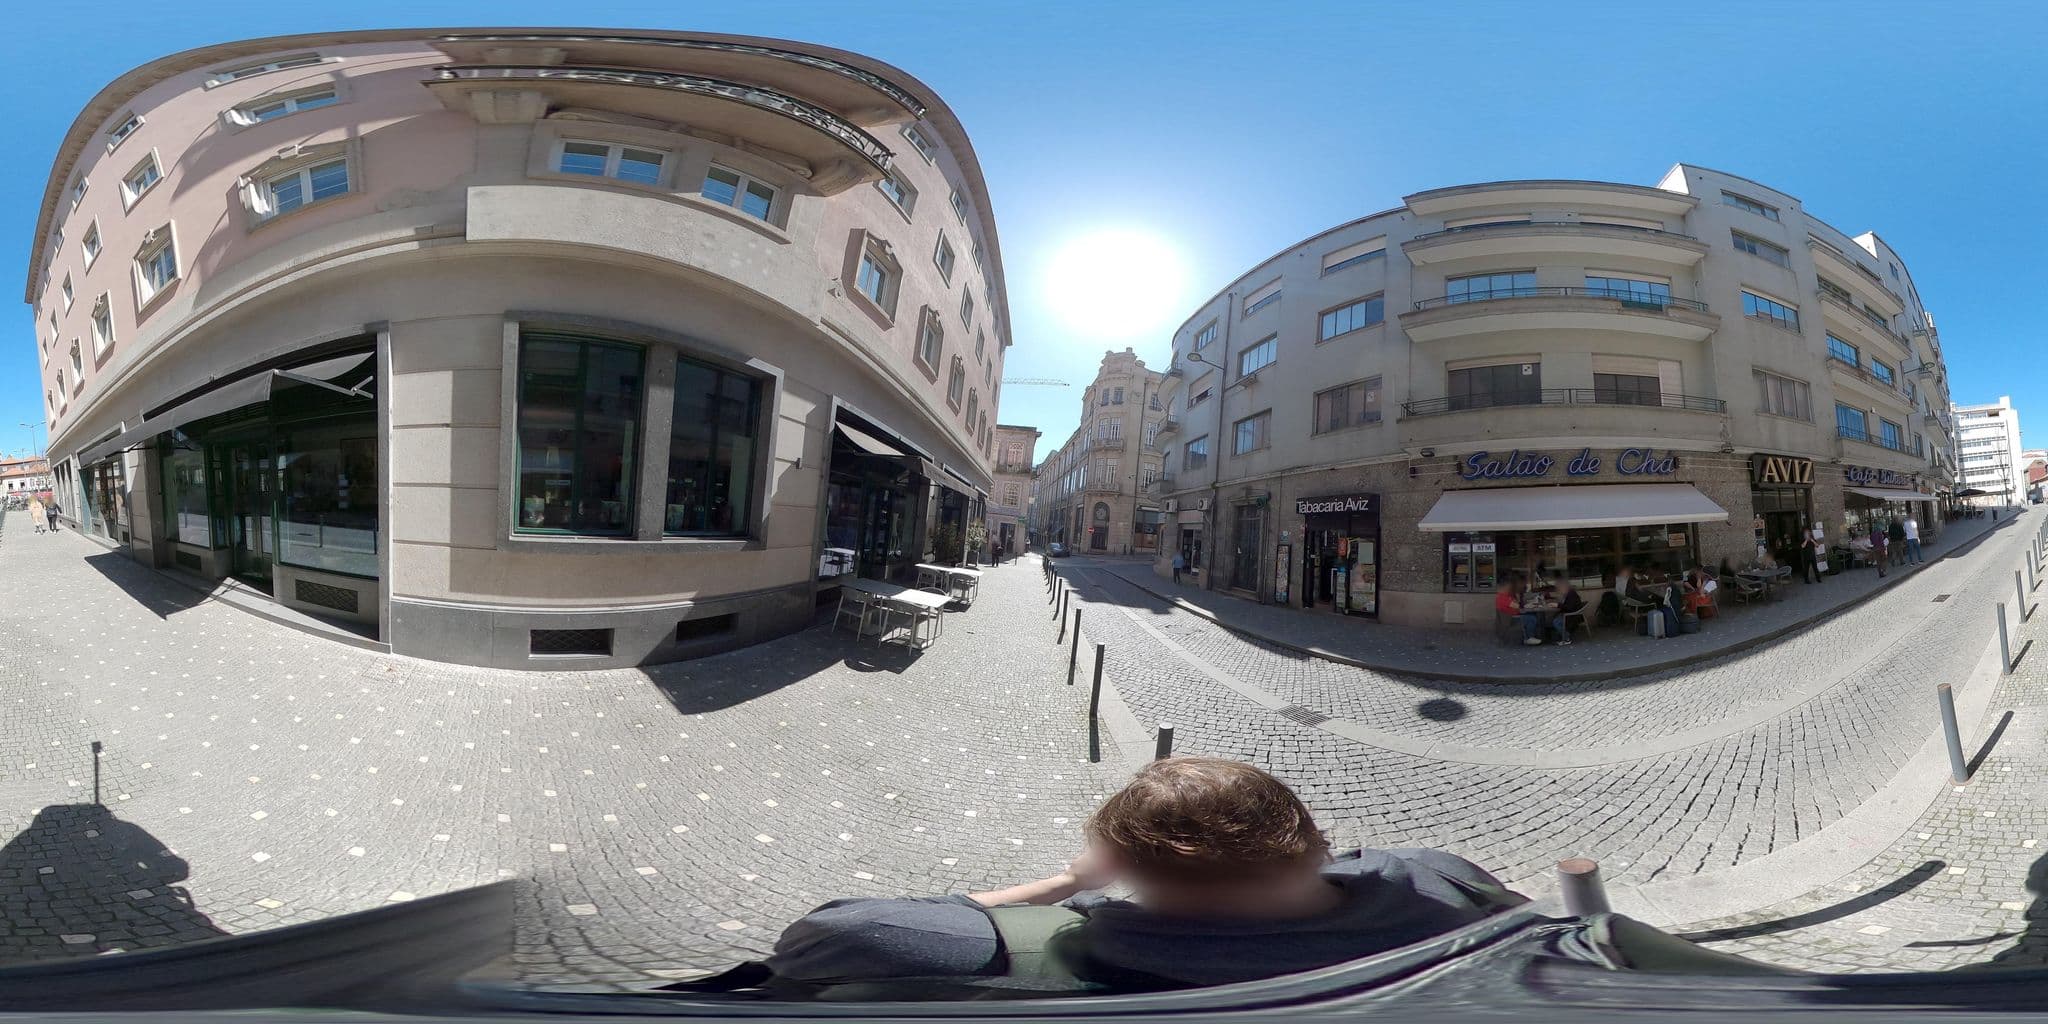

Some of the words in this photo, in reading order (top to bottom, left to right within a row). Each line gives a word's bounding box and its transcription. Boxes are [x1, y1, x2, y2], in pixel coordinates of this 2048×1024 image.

[1463, 449, 1554, 480] Salão
[1568, 448, 1601, 476] de
[1763, 456, 1814, 484] AVIZ
[1297, 499, 1345, 514] Tabacaria
[1345, 497, 1368, 511] Aviz
